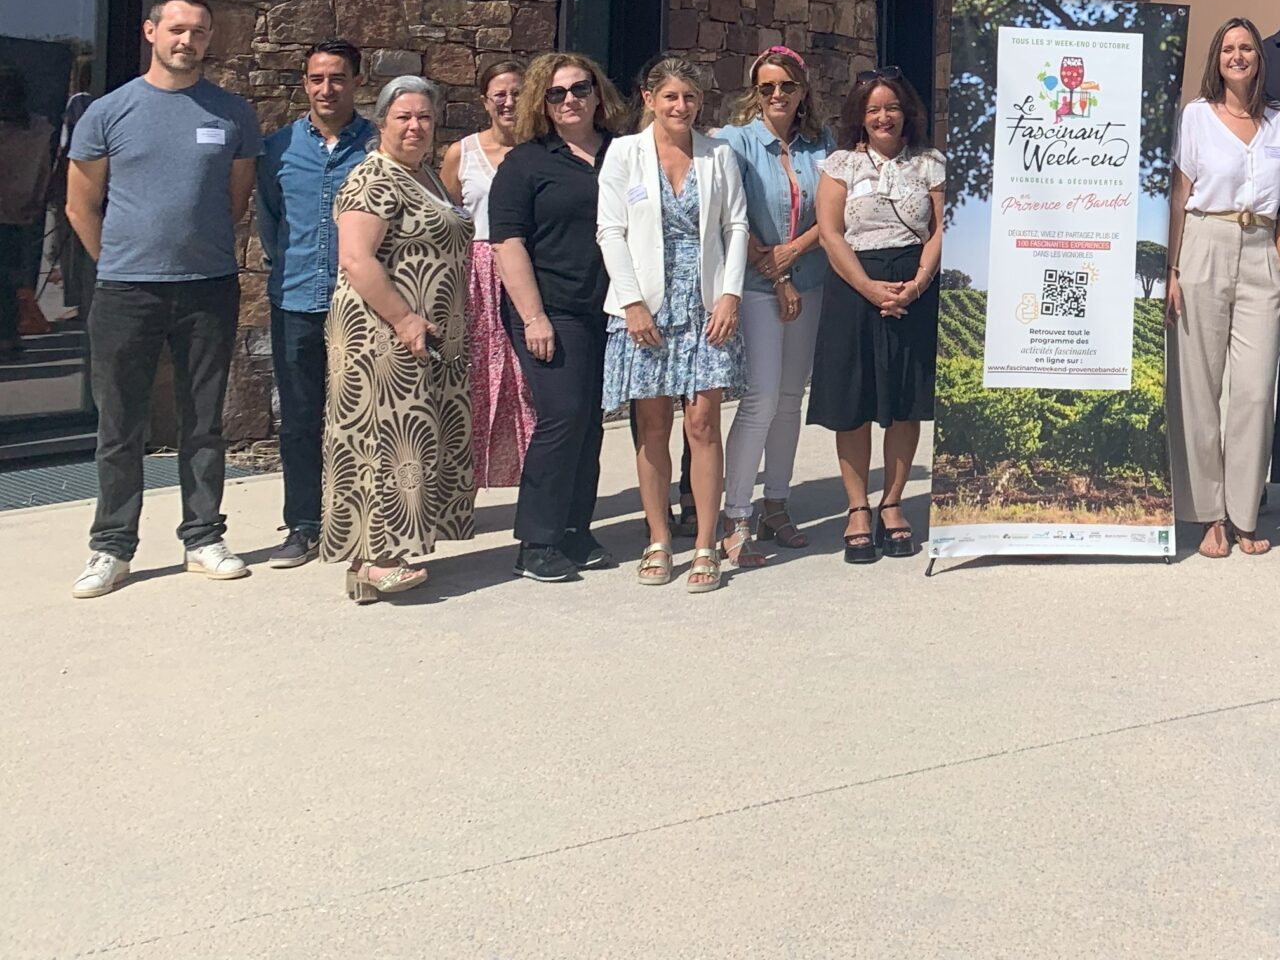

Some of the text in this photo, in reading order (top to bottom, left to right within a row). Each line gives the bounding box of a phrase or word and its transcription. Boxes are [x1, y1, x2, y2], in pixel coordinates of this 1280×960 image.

[1012, 37, 1029, 45] TOUS
[1031, 38, 1044, 46] LES
[1055, 40, 1090, 49] WEEK-END
[1013, 95, 1036, 115] Le
[1006, 114, 1126, 146] Fascinant
[1023, 138, 1130, 173] Week-end
[1010, 176, 1055, 185] VIGNOBLES
[1001, 191, 1133, 215] Provence et Bandol
[1065, 231, 1094, 239] PARTAGEZ
[1095, 232, 1111, 240] PLUS
[1018, 240, 1029, 248] 100
[1030, 240, 1069, 248] FASCINANTES
[1033, 250, 1049, 258] DANS
[1062, 251, 1094, 259] VIGNOBLES
[1029, 328, 1066, 336] Retrouvez
[1030, 337, 1074, 346] programme
[1054, 346, 1097, 357] fascinantes
[1046, 357, 1065, 365] ligne
